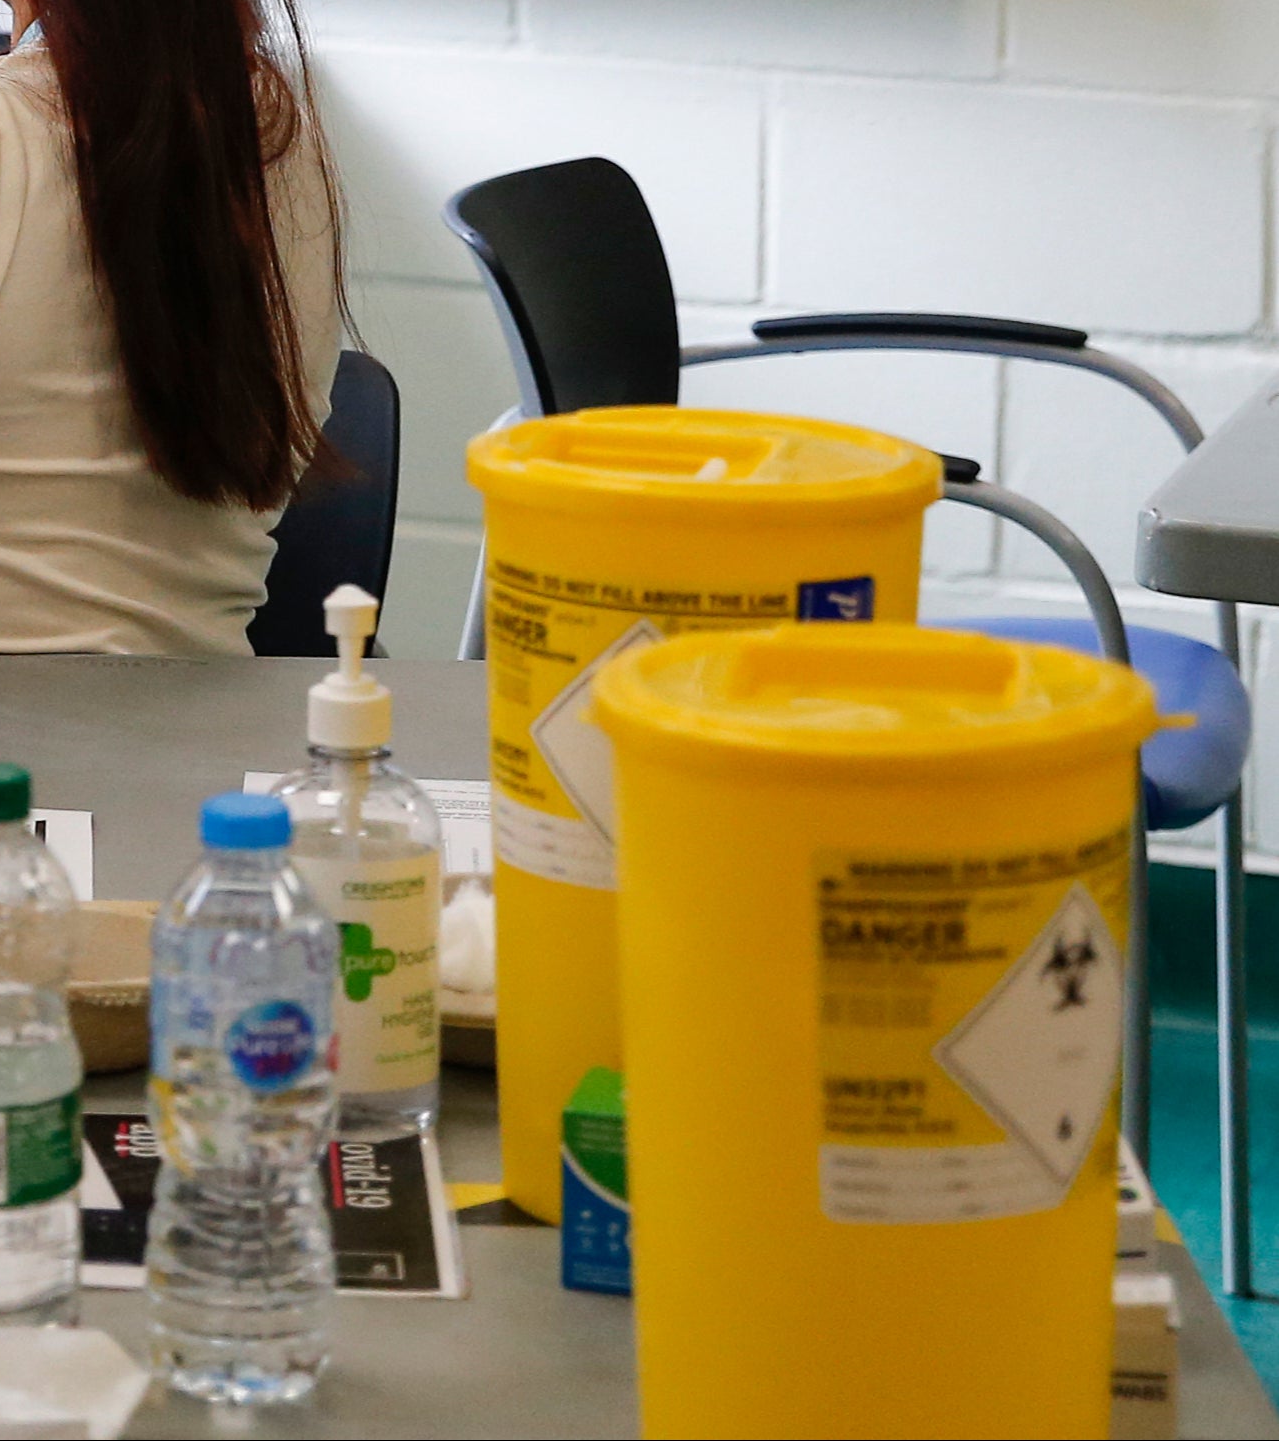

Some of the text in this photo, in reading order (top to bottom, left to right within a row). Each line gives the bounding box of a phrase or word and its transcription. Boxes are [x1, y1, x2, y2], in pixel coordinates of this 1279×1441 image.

[642, 590, 701, 607] ABOVE
[709, 593, 741, 608] THE
[343, 1141, 392, 1210] ovid-19
